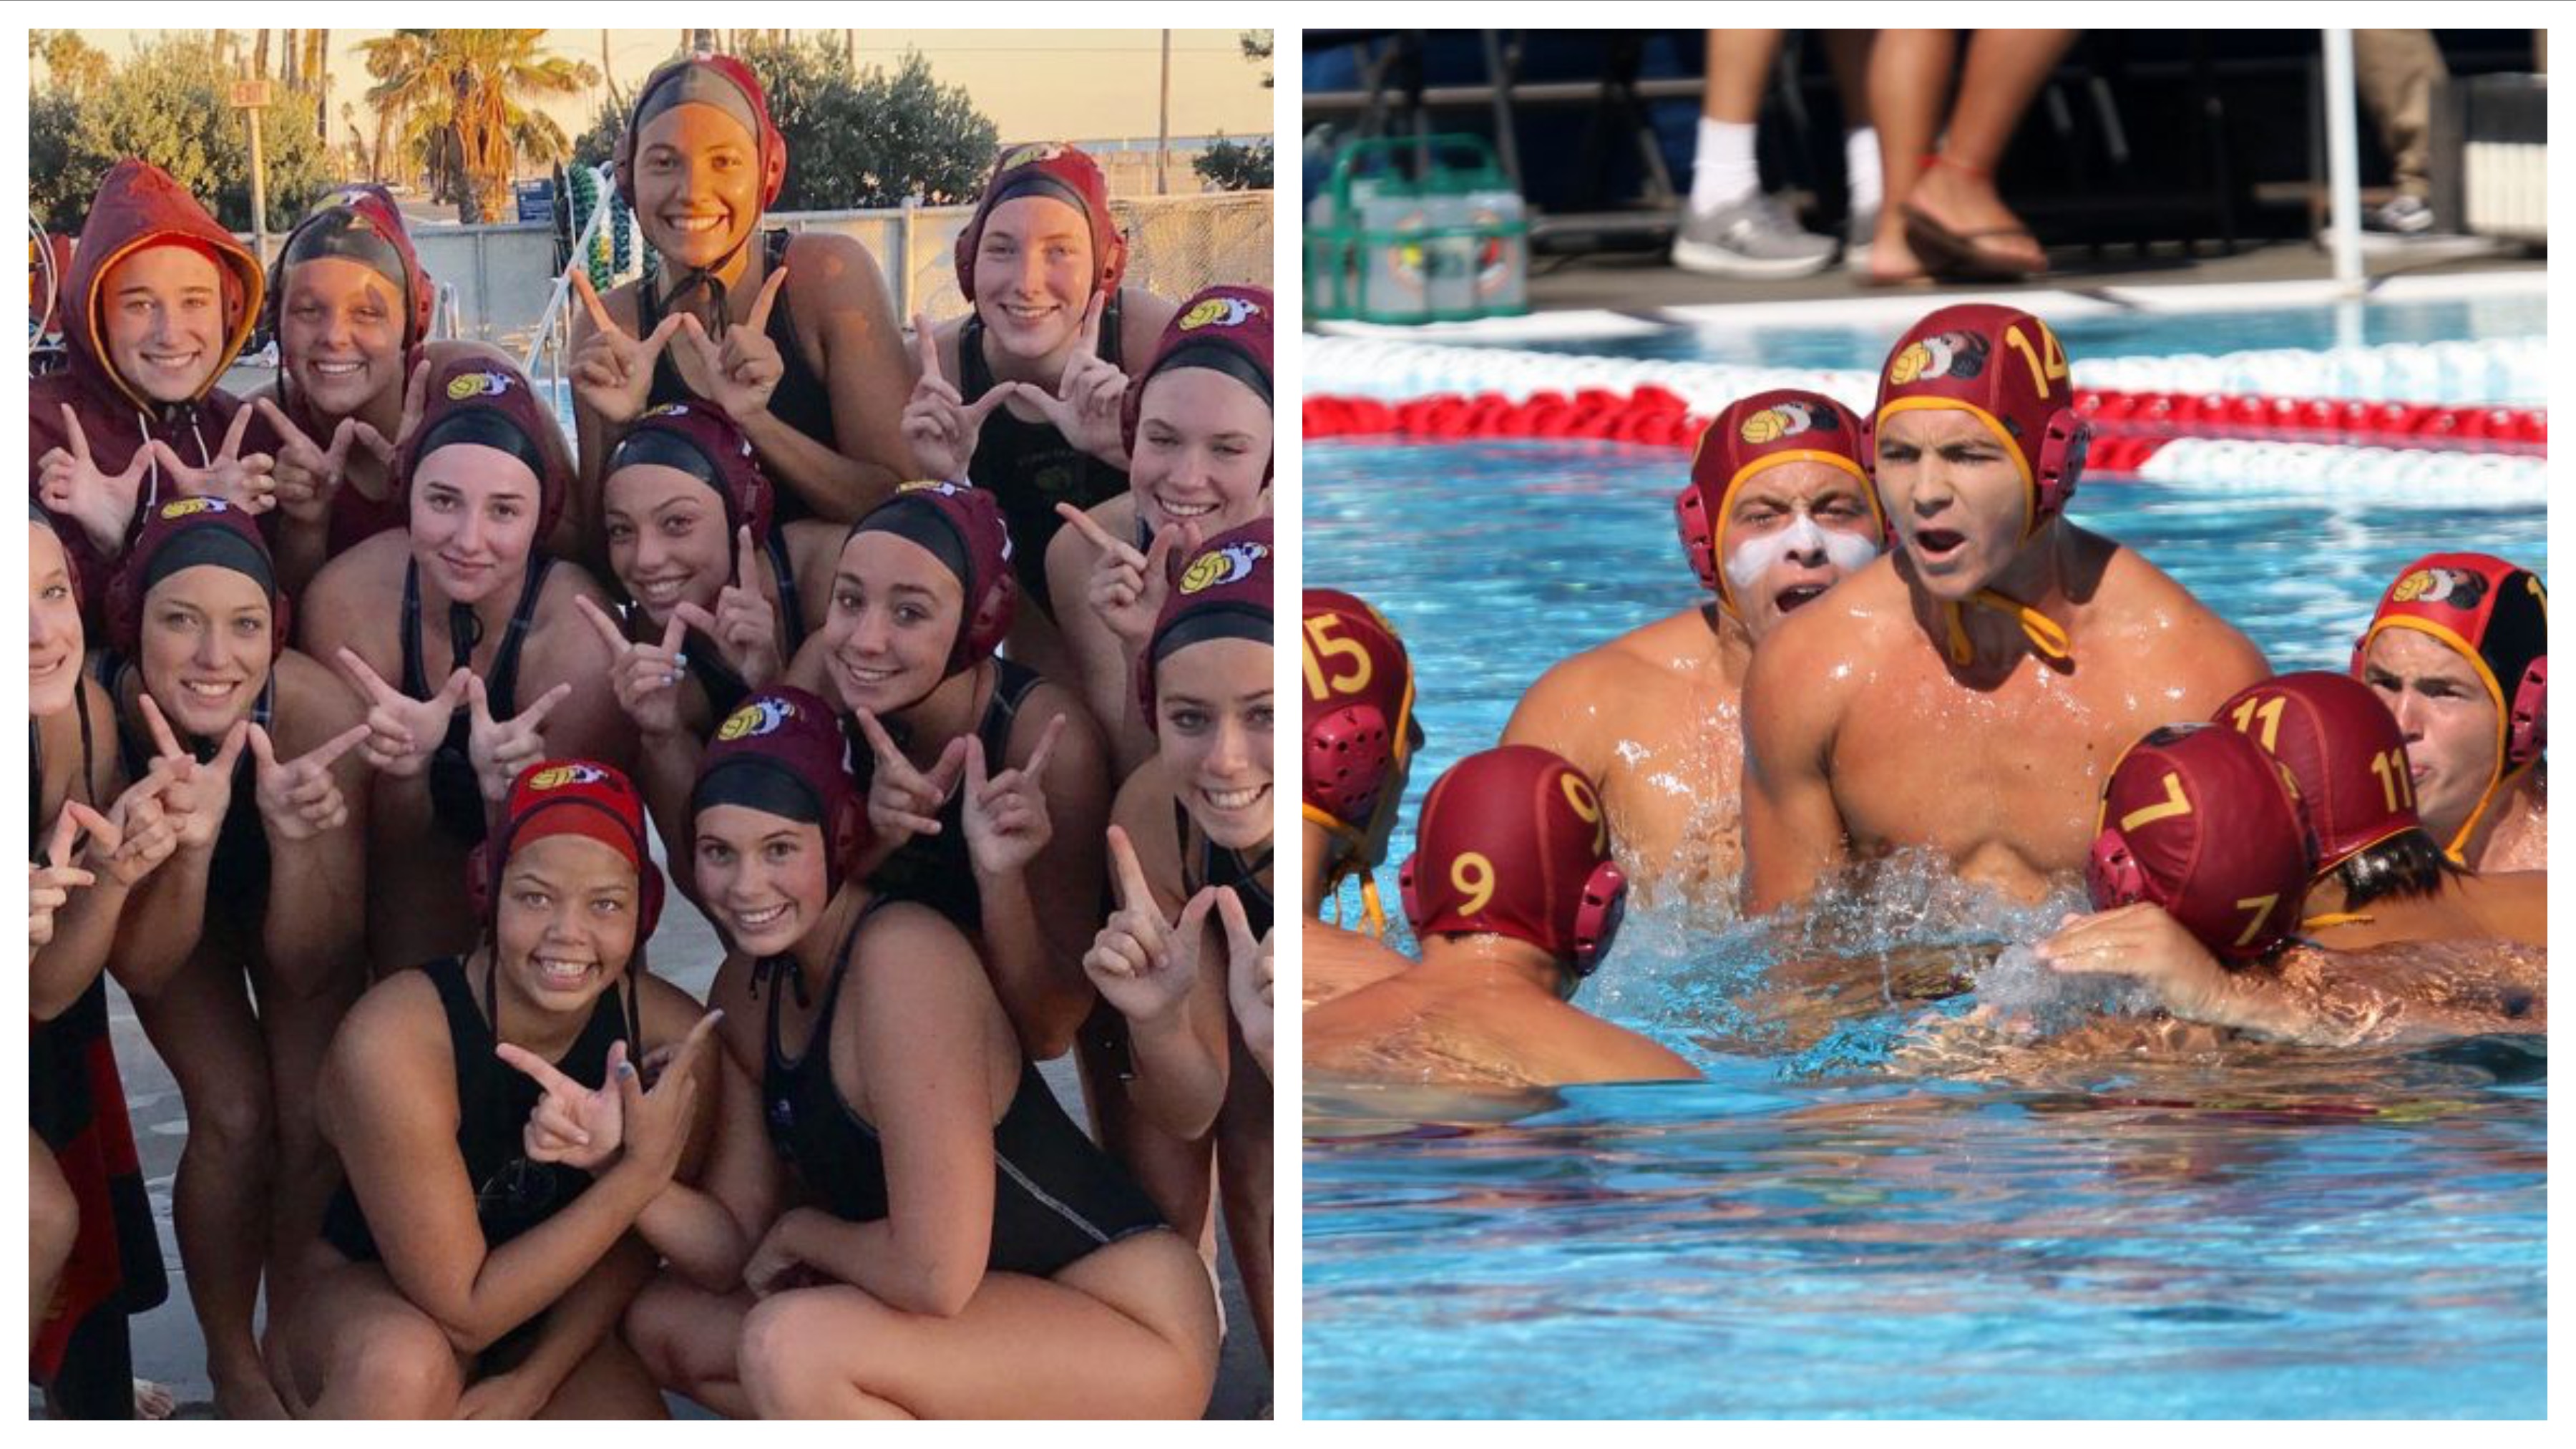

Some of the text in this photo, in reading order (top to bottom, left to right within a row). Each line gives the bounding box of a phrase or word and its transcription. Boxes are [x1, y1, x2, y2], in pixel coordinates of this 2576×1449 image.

[2006, 319, 2068, 399] 14
[2120, 771, 2192, 832] 7
[2371, 748, 2412, 813] 11
[1561, 772, 1606, 858] 9
[1450, 852, 1496, 917] 9
[2235, 892, 2280, 946] 7
